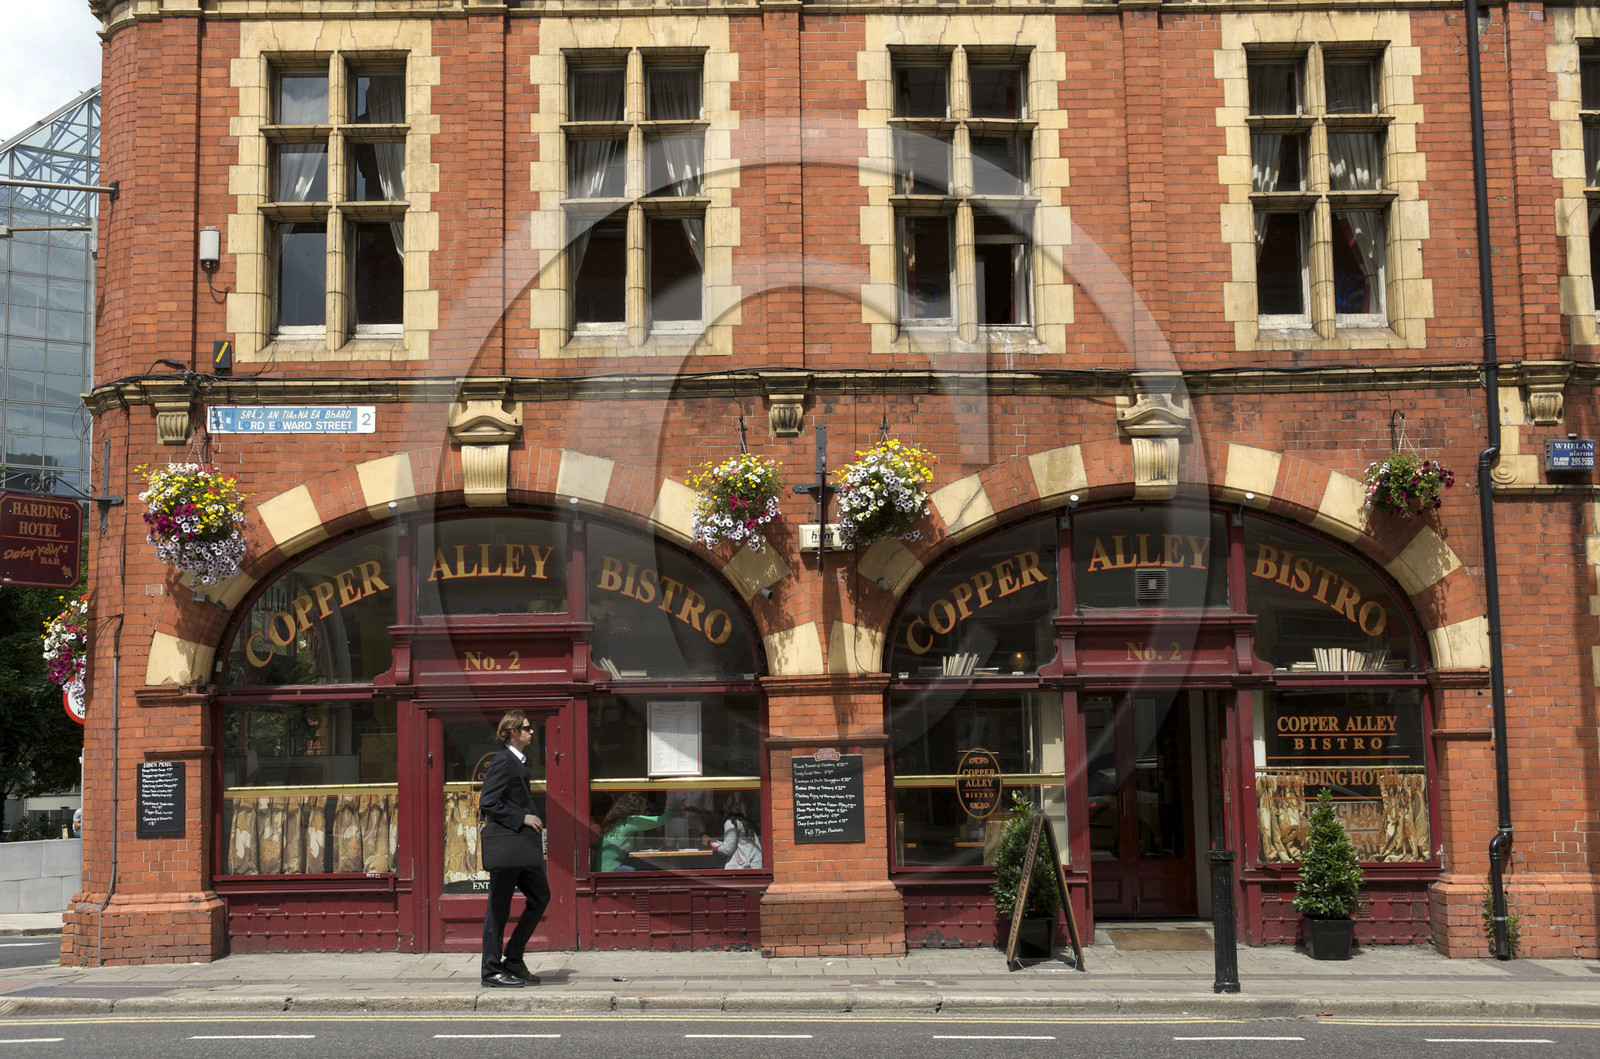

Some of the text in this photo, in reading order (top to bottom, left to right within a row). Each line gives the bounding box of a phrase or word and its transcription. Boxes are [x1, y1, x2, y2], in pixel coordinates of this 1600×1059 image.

[267, 411, 278, 419] AN
[362, 413, 371, 426] 2
[238, 421, 353, 431] LORD EDWARD STREET
[12, 501, 69, 520] HARDING
[19, 521, 61, 537] HOTEL
[40, 556, 61, 565] BAR
[906, 533, 1387, 655] COPPER ALLEY BISTRO
[246, 543, 732, 668] COPPER ALLEY BISTRO
[1125, 642, 1182, 661] No. 2
[463, 650, 521, 671] No. 2
[1277, 715, 1398, 732] COPPER ALLEY
[1293, 737, 1383, 750] BISTRO
[963, 769, 995, 777] COPPER
[1276, 769, 1400, 786] HARDING HOTEL
[965, 779, 993, 787] ALLEY
[1350, 833, 1388, 845] BAR
